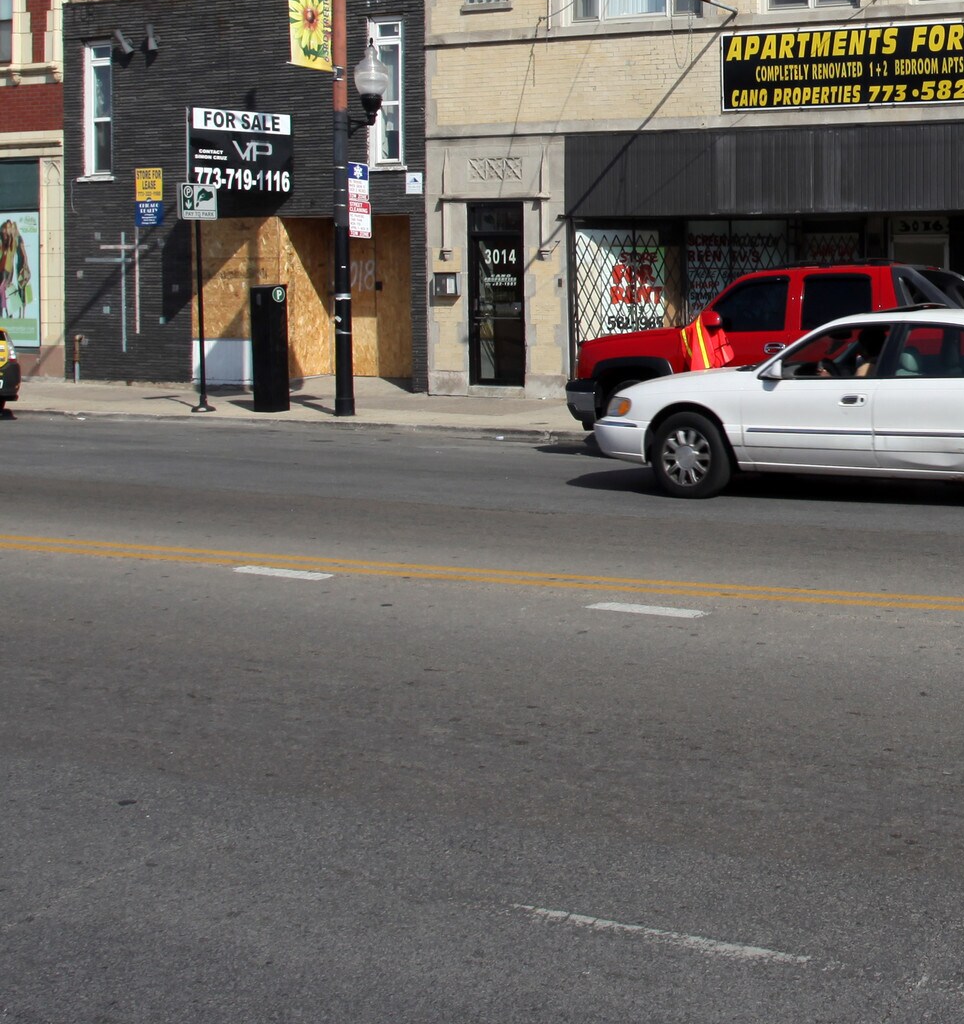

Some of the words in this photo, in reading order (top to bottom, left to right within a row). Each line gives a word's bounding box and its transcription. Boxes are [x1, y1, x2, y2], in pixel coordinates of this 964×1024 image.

[726, 27, 899, 62] APARTMENTS
[911, 23, 964, 53] FOR
[755, 62, 809, 83] COMPLETELY
[812, 60, 863, 80] RENOVATED
[894, 57, 939, 76] BEDROOM
[941, 56, 964, 74] APTS
[731, 88, 768, 108] CANO
[773, 84, 862, 106] PROPERTIES
[203, 110, 236, 129] FOR
[241, 113, 281, 132] SALE
[198, 148, 224, 156] CONTACT
[136, 169, 152, 179] STORE
[152, 169, 161, 179] FOR
[194, 166, 291, 193] 773-719-1116
[141, 180, 157, 190] LEASE
[484, 248, 517, 265] 3014
[619, 251, 658, 264] STORE
[610, 286, 663, 305] RENT
